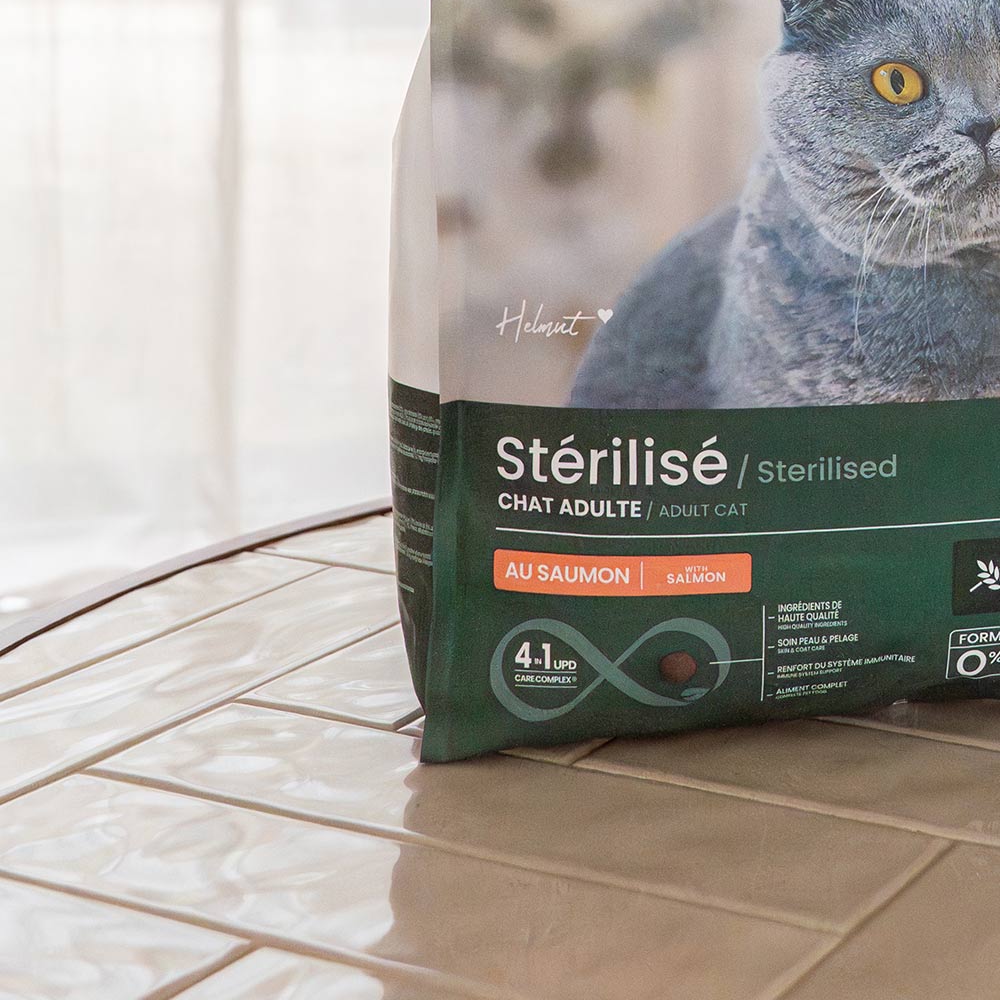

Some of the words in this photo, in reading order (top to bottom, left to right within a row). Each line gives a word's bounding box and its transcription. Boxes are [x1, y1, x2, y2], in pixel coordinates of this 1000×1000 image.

[496, 299, 597, 343] Helmut
[496, 434, 728, 486] Stérilisé
[757, 453, 897, 484] Sterilised
[497, 492, 554, 513] CHAT
[559, 498, 642, 518] ADULTE
[659, 503, 710, 518] ADULT
[714, 502, 748, 517] CAT
[505, 561, 533, 580] AU
[537, 563, 630, 584] SAUMON
[666, 572, 726, 585] SALMON
[777, 601, 831, 613] INGRÉDIENTS
[832, 600, 842, 609] DE
[777, 613, 805, 623] HAUTE
[806, 610, 840, 621] QUALITÉ
[777, 638, 798, 648] SOIN
[798, 636, 820, 645] PEAU
[821, 635, 828, 644] &
[829, 633, 859, 643] PELAGE
[553, 660, 577, 670] UPD
[777, 663, 813, 673] RENFORT
[814, 661, 827, 670] DU
[827, 658, 863, 669] SYSTÈME
[863, 654, 916, 665] IMMUNITAIRE
[514, 674, 535, 682] CARE
[776, 685, 810, 695] ALIMENT
[811, 681, 848, 690] COMPLET
